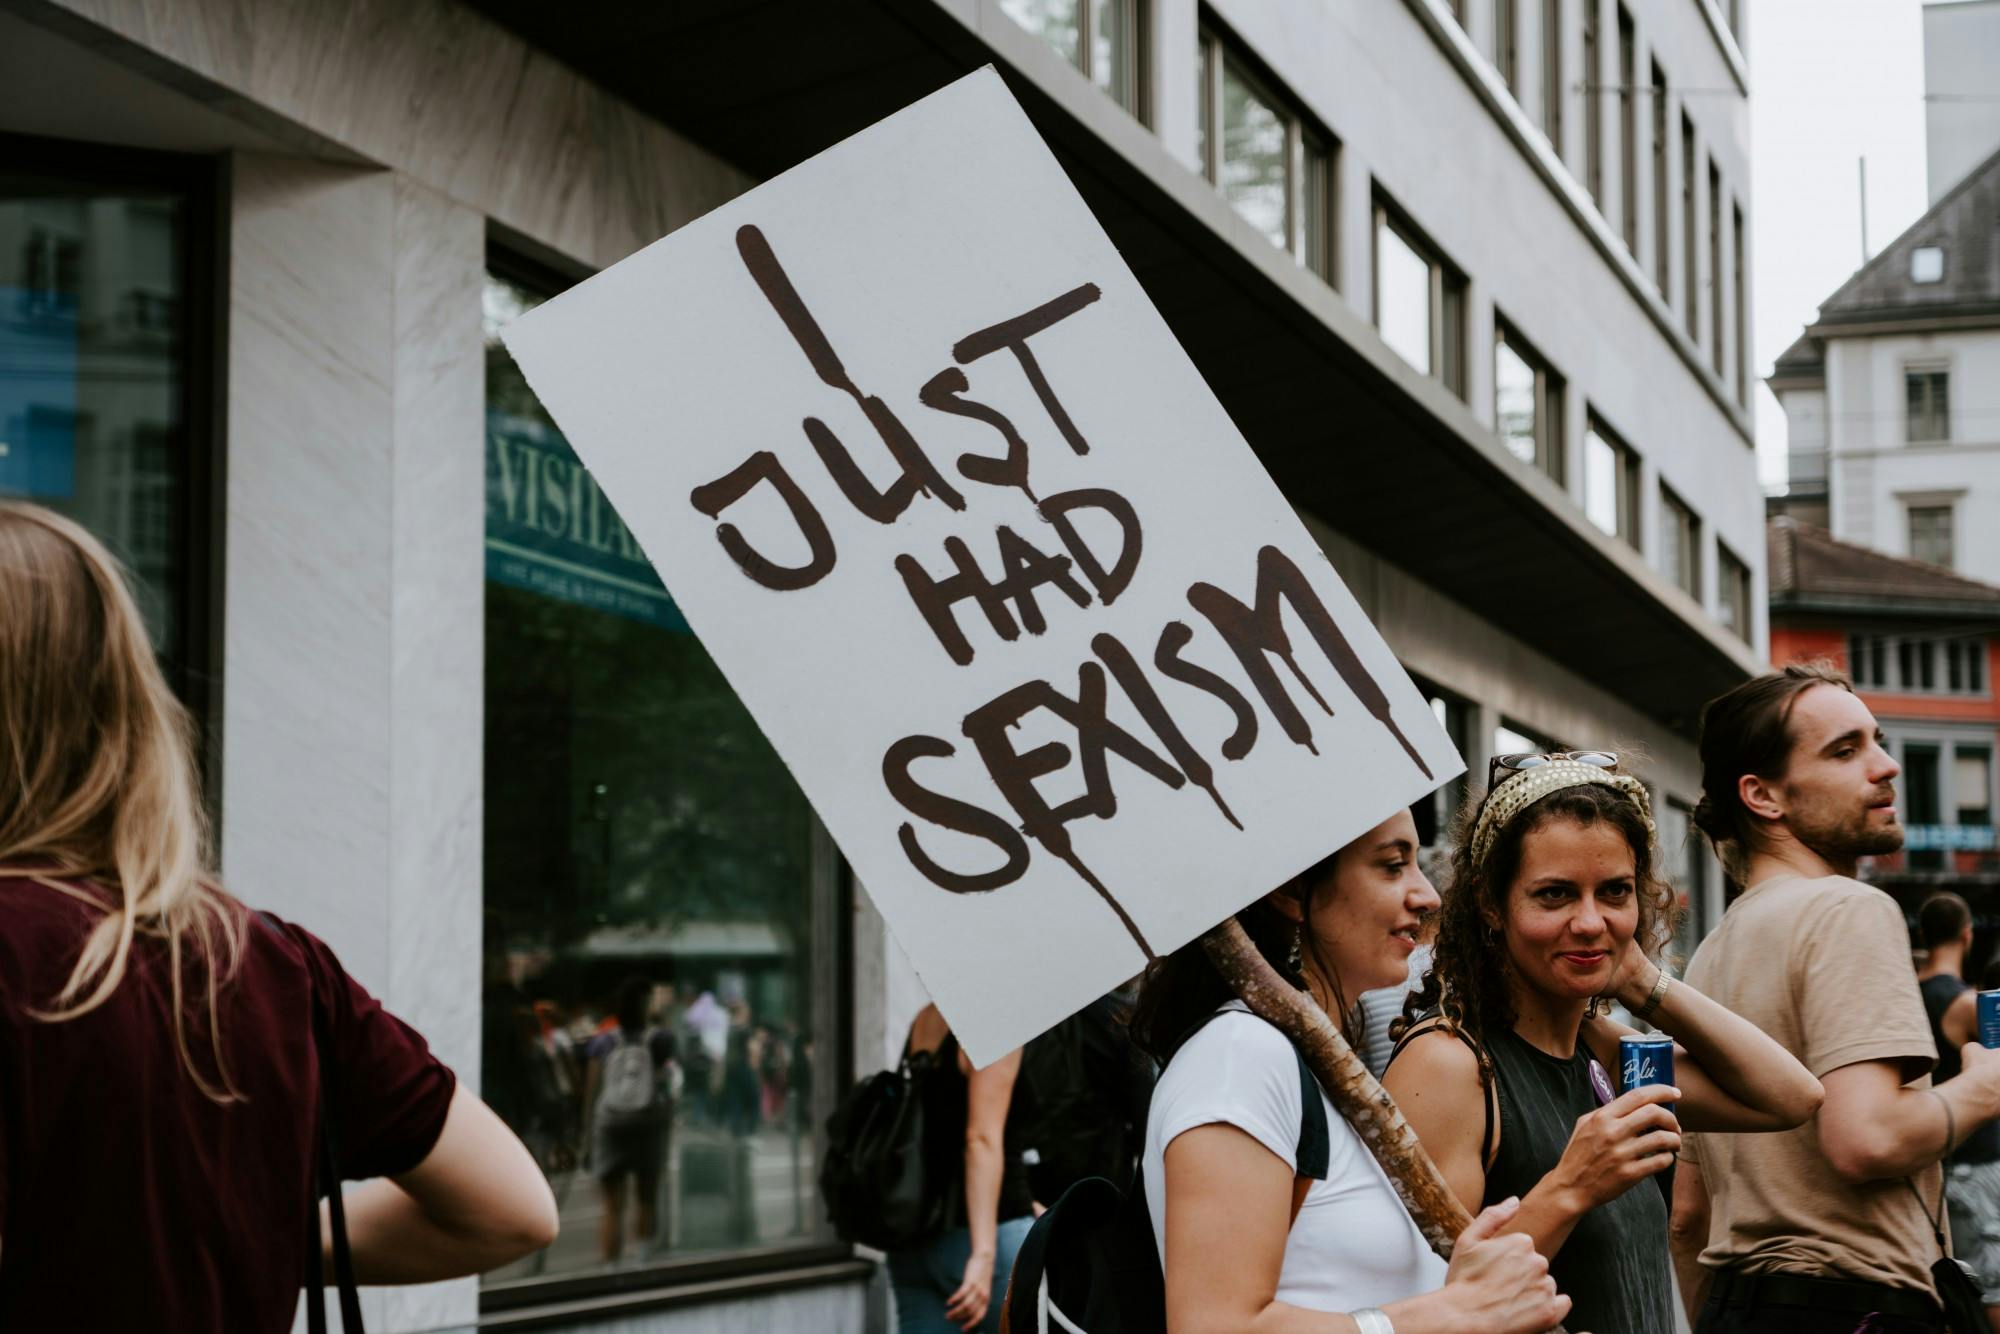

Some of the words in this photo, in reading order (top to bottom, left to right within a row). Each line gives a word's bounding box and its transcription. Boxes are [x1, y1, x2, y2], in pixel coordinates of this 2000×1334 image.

[736, 224, 846, 389] I
[494, 432, 650, 563] VISILA
[690, 282, 1102, 591] JUST
[895, 488, 1142, 666] HAD
[882, 545, 1433, 895] SEXISM
